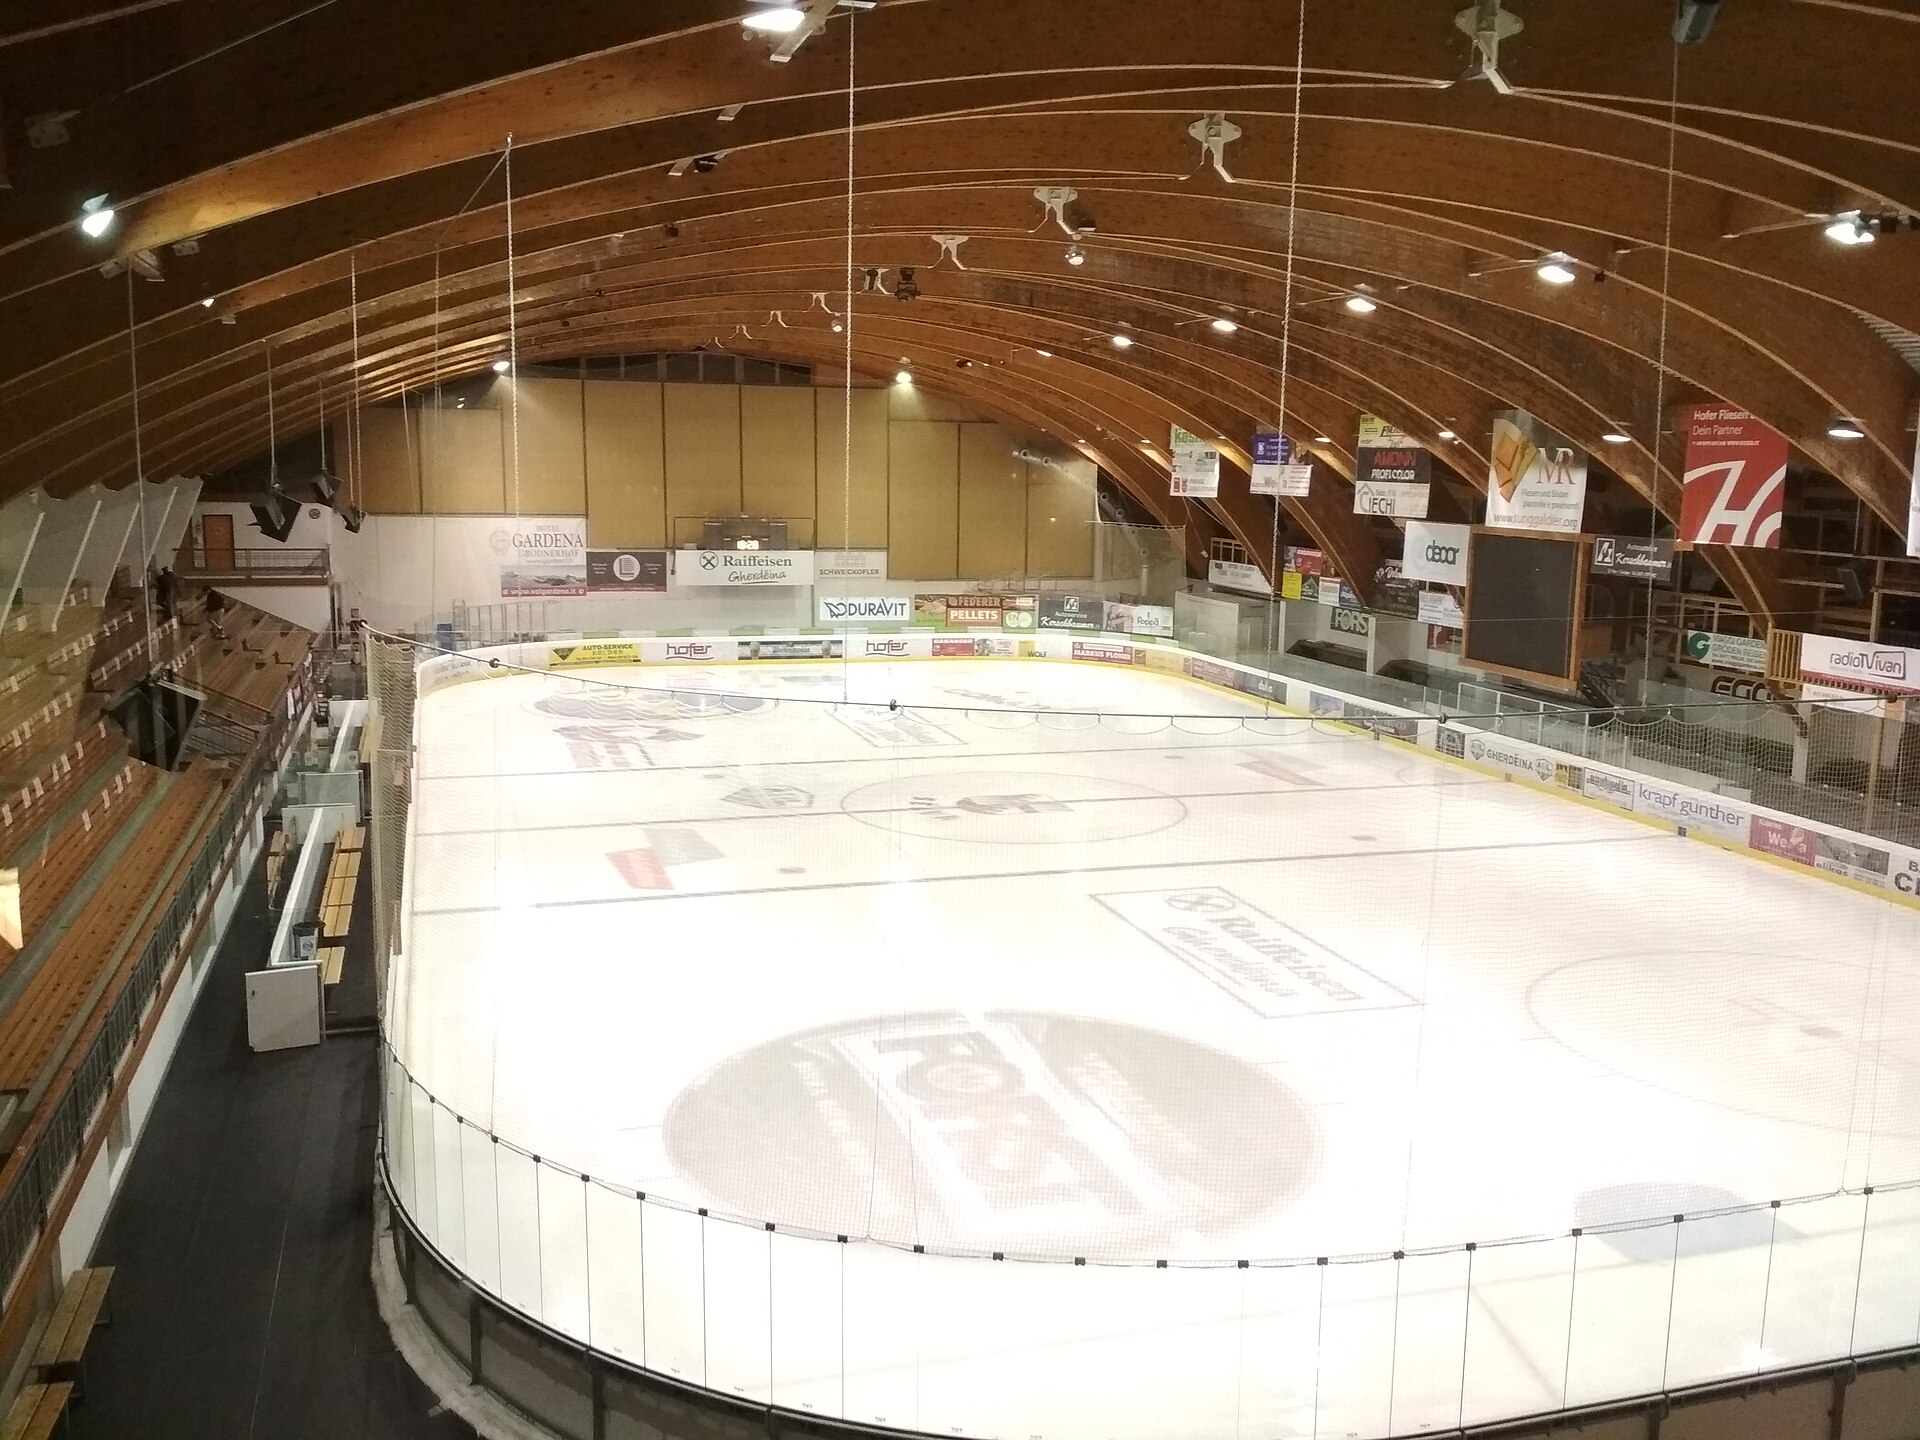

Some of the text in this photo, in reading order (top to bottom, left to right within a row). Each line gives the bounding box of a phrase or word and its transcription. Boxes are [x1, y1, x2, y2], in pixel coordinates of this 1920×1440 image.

[1693, 409, 1718, 420] Hofer
[1692, 424, 1743, 436] Dein Partner
[512, 533, 584, 548] GARDENA
[722, 554, 793, 568] Raiffeisen
[848, 598, 907, 617] DURAVIT
[950, 609, 999, 620] PELLETS
[582, 643, 633, 651] AUTO-SERVICE
[665, 643, 713, 656] hofer
[866, 640, 909, 652] hofer
[1028, 650, 1047, 658] WOLF
[1073, 649, 1105, 658] MARKUS
[1639, 783, 1680, 808] krapf
[1206, 915, 1367, 1002] Raiffeisen
